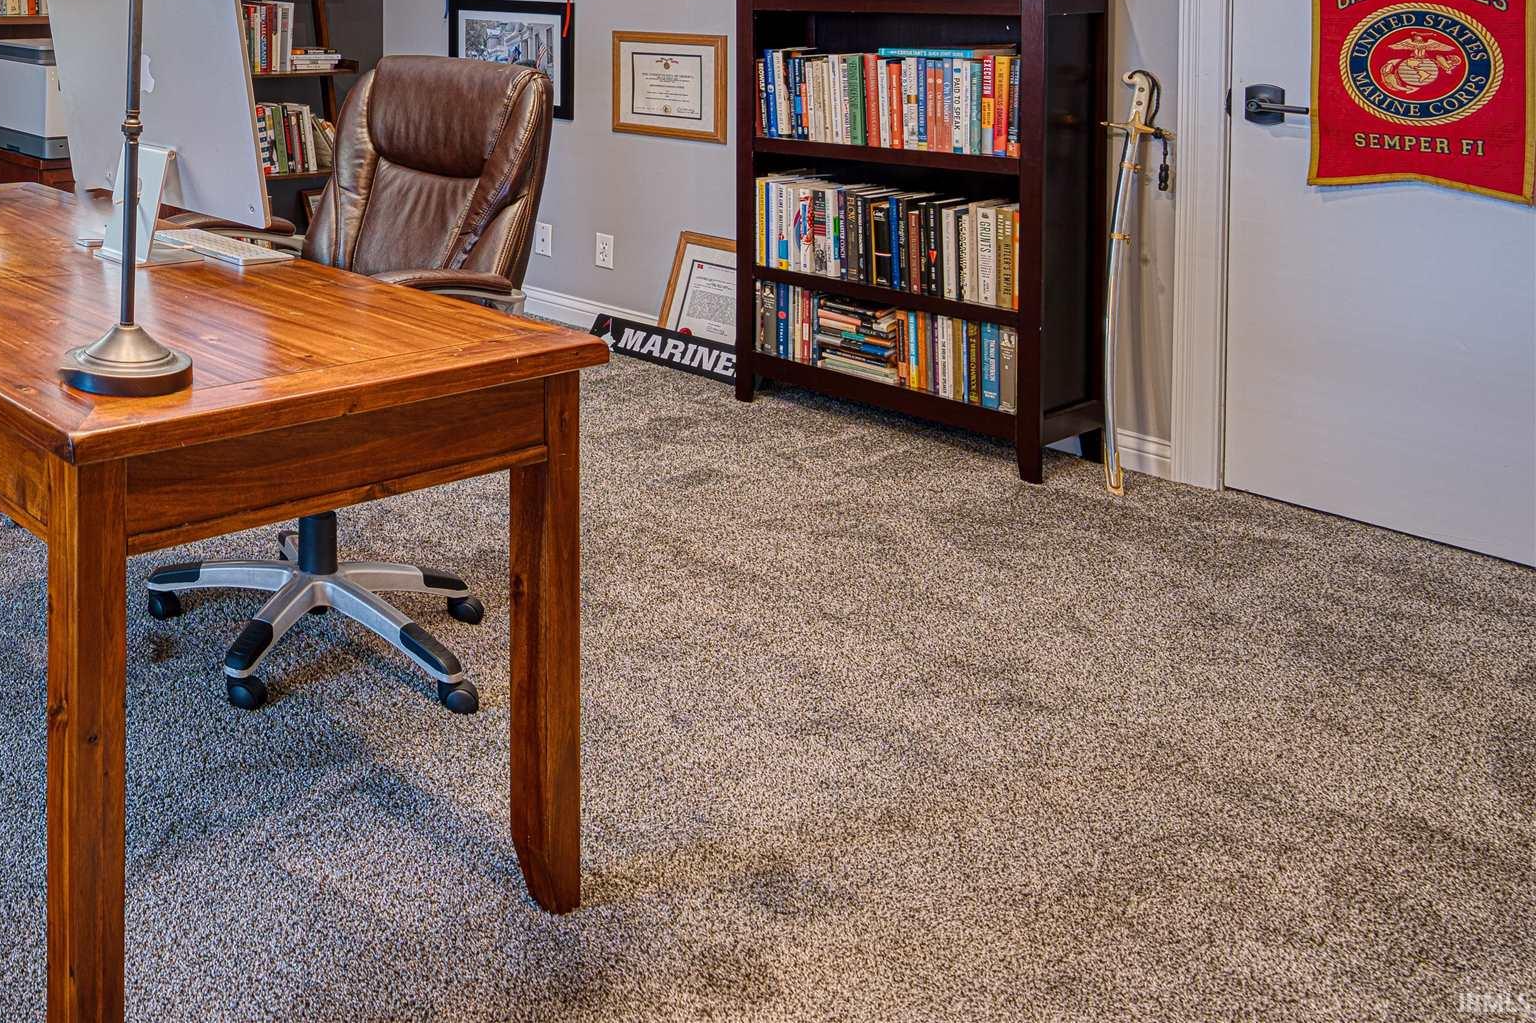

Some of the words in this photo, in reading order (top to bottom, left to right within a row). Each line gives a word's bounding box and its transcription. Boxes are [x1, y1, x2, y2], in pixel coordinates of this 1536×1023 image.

[1354, 12, 1417, 59] UNITED
[1424, 13, 1489, 62] STATES
[943, 81, 951, 94] On
[983, 59, 992, 95] EXECUTION
[943, 95, 951, 123] Mission
[954, 95, 960, 104] TO
[1353, 71, 1421, 117] MARINE
[1429, 73, 1488, 116] CORPS
[1354, 132, 1451, 154] SEMPER
[1461, 139, 1485, 157] FI
[959, 222, 967, 269] LEADERSHIP
[979, 221, 991, 253] GRUNTS
[1003, 243, 1011, 271] HITLER'S
[1003, 273, 1011, 296] EMPIRE
[617, 327, 737, 378] MARINE
